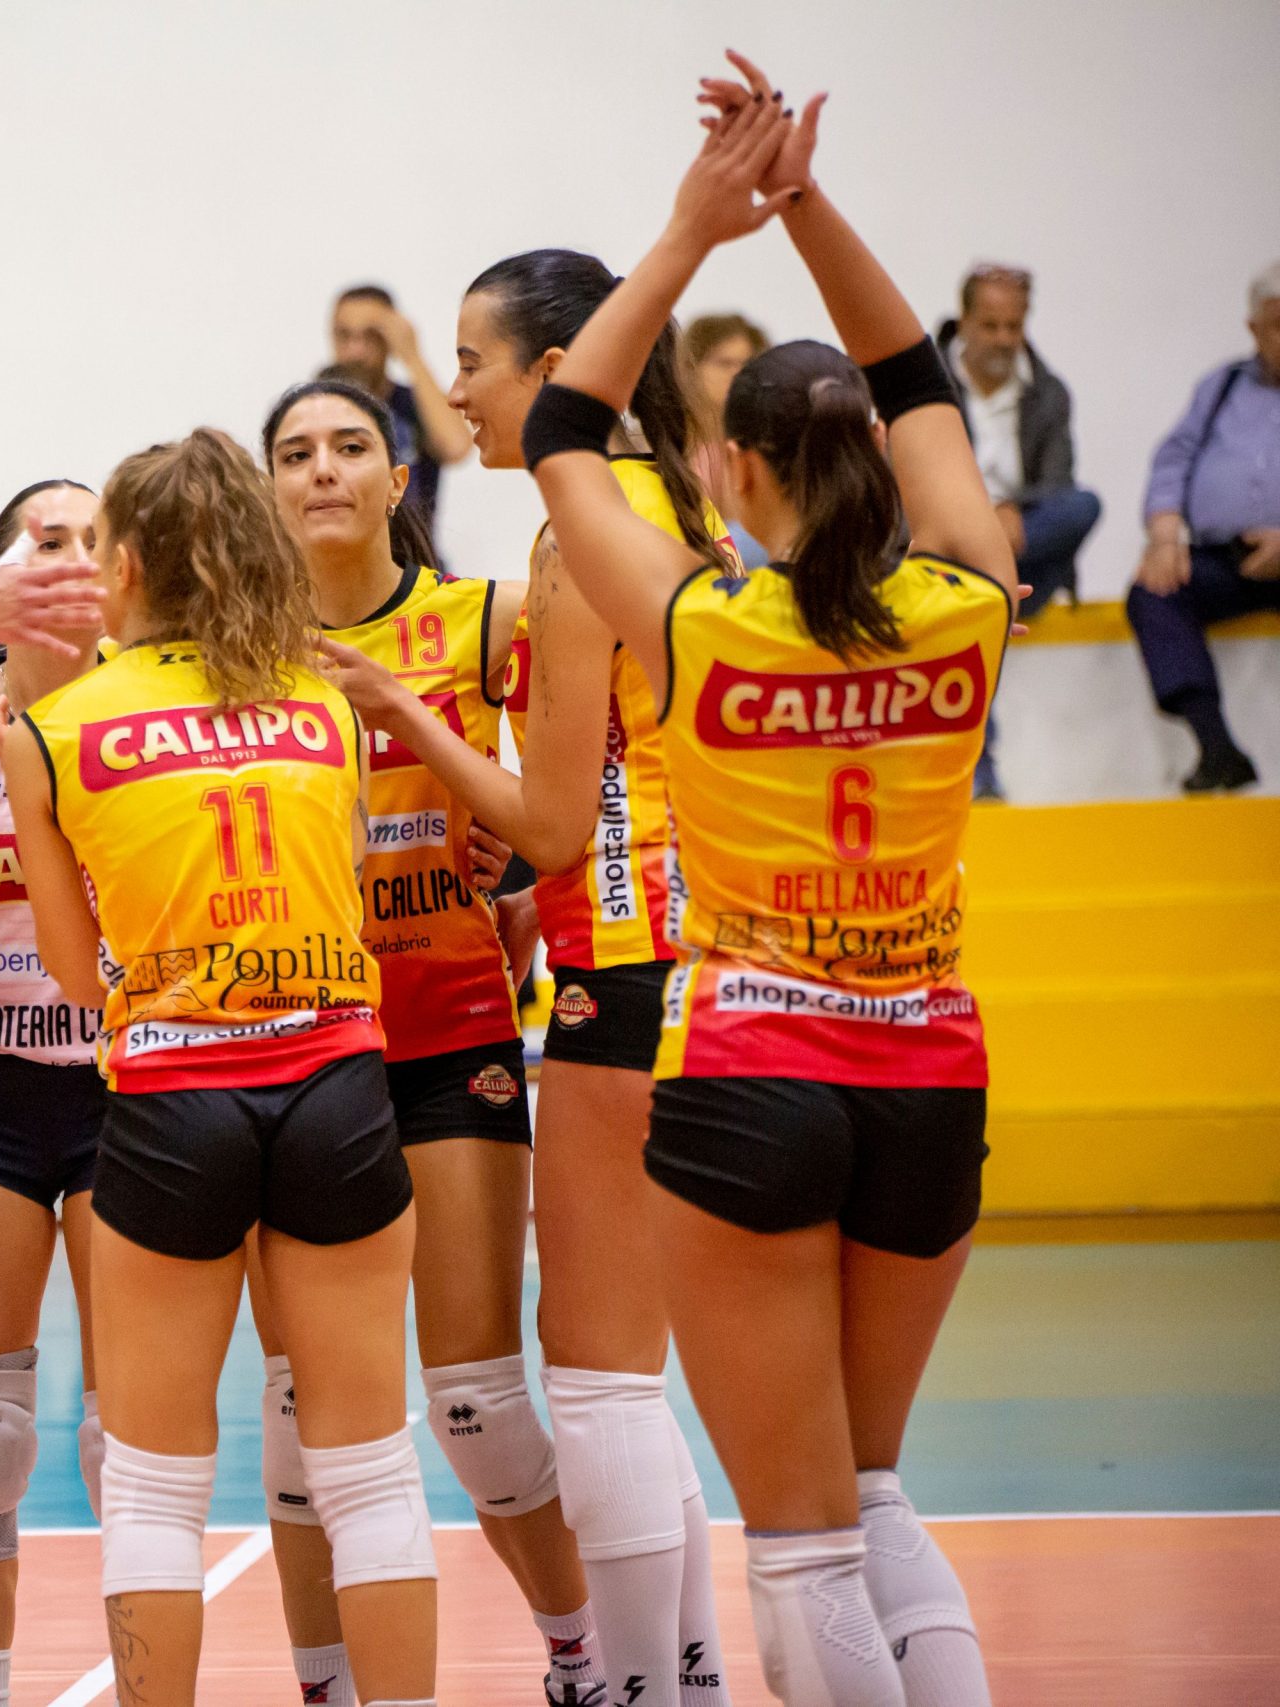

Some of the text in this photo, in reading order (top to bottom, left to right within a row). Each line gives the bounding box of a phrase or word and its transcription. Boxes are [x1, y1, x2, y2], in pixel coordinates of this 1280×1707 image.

[390, 612, 448, 668] 19
[720, 667, 974, 734] CALLIPO
[100, 704, 327, 771] CALLIPO
[200, 750, 258, 765] DAL 1913
[199, 782, 279, 882] 11
[367, 812, 447, 843] metis
[828, 763, 878, 866] 6
[208, 887, 290, 930] CURTI
[373, 869, 473, 921] CALLIPO
[775, 868, 927, 914] BELLANCA
[200, 933, 368, 993] Popilia
[219, 967, 317, 1012] Country
[473, 1080, 516, 1093] CALLIPO
